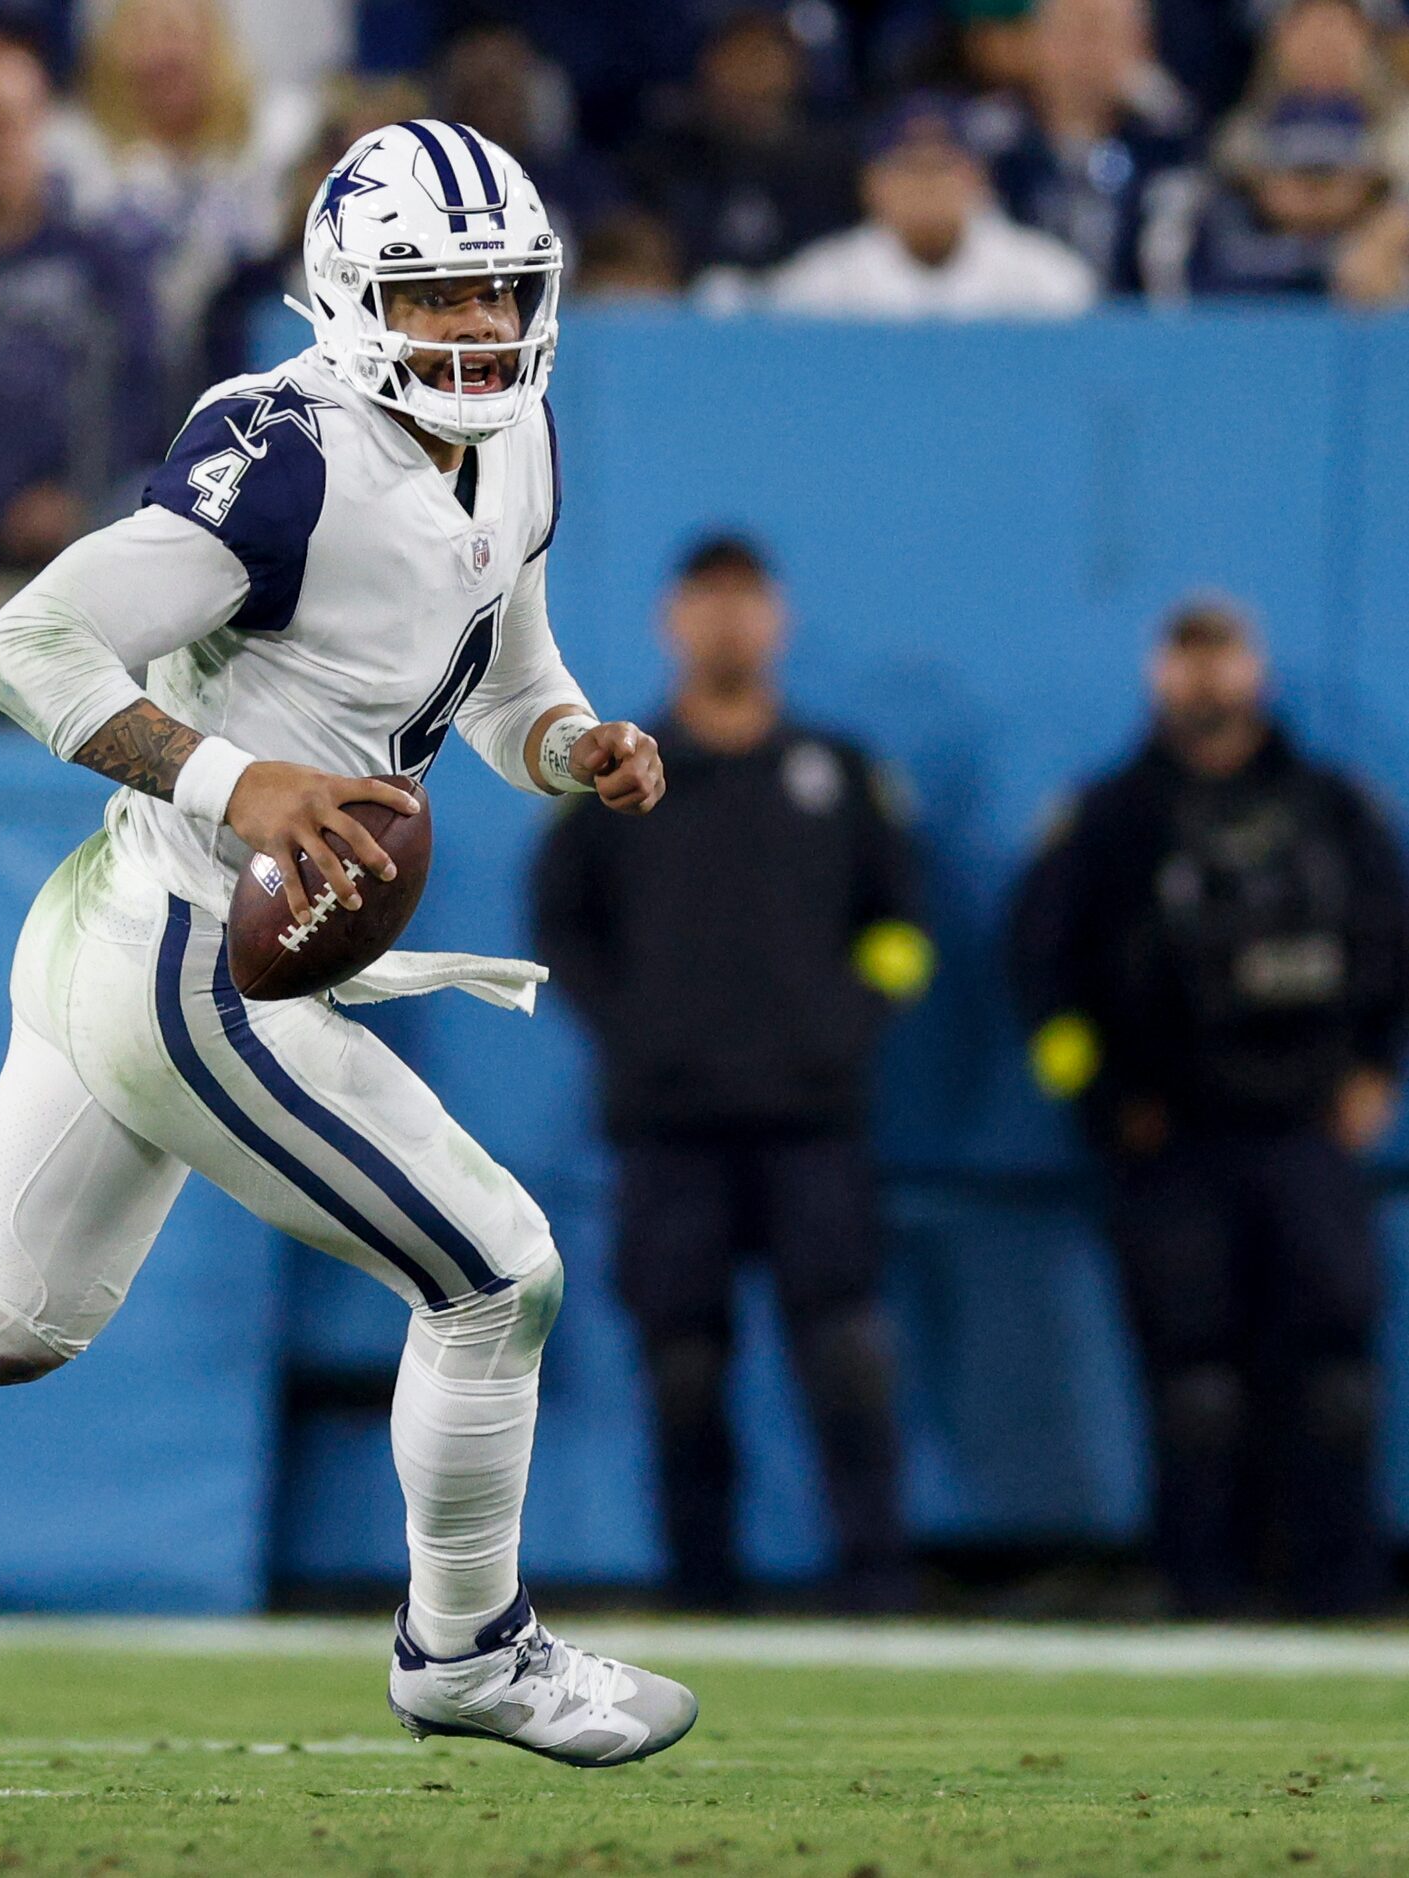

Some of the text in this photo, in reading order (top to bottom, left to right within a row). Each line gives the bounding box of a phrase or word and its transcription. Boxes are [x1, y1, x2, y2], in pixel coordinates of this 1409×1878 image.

[459, 240, 505, 251] COWBOYS
[187, 447, 252, 527] 4
[389, 592, 503, 783] 4
[548, 749, 571, 775] FAIT
